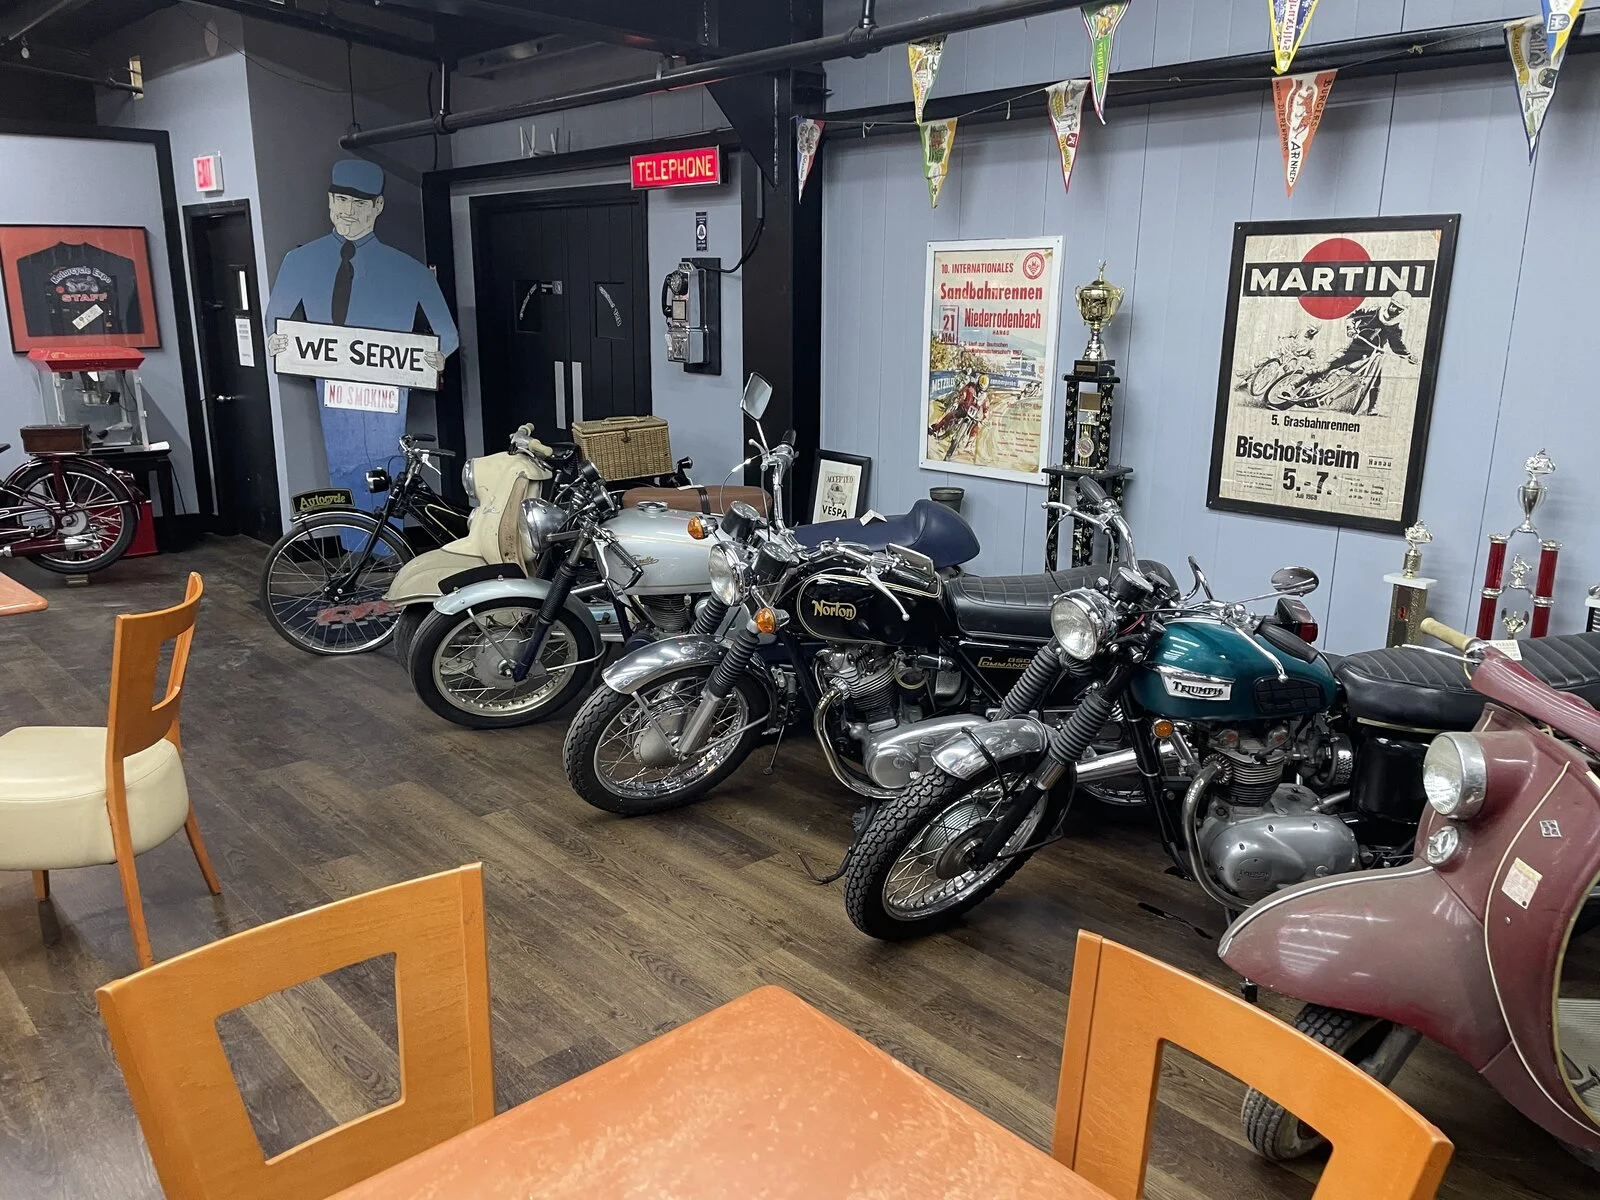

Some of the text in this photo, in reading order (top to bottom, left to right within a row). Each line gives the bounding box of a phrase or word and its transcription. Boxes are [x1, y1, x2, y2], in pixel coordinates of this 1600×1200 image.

[637, 155, 714, 182] TELEPHONE
[1289, 140, 1301, 183] ARNHEM
[50, 265, 91, 284] Motorcycle
[92, 267, 111, 283] Expo
[941, 262, 1014, 274] 10. INTERNATIONALES
[1250, 265, 1426, 292] MARTINI
[62, 292, 107, 302] STAFF
[940, 281, 1043, 300] Sandbahnrennen
[943, 314, 955, 331] 21
[964, 308, 1041, 329] Niederrodenbach
[941, 332, 955, 342] MAI
[295, 336, 424, 372] WE SERVE
[329, 384, 395, 409] NO SMOKING
[1271, 414, 1360, 433] 5. Grasbahnrennen
[1236, 435, 1391, 469] Bischofsheim Hanau
[300, 493, 346, 510] Autocycle
[822, 505, 847, 518] VESPA
[811, 599, 856, 620] Norton
[1173, 681, 1223, 698] TRIUMPH
